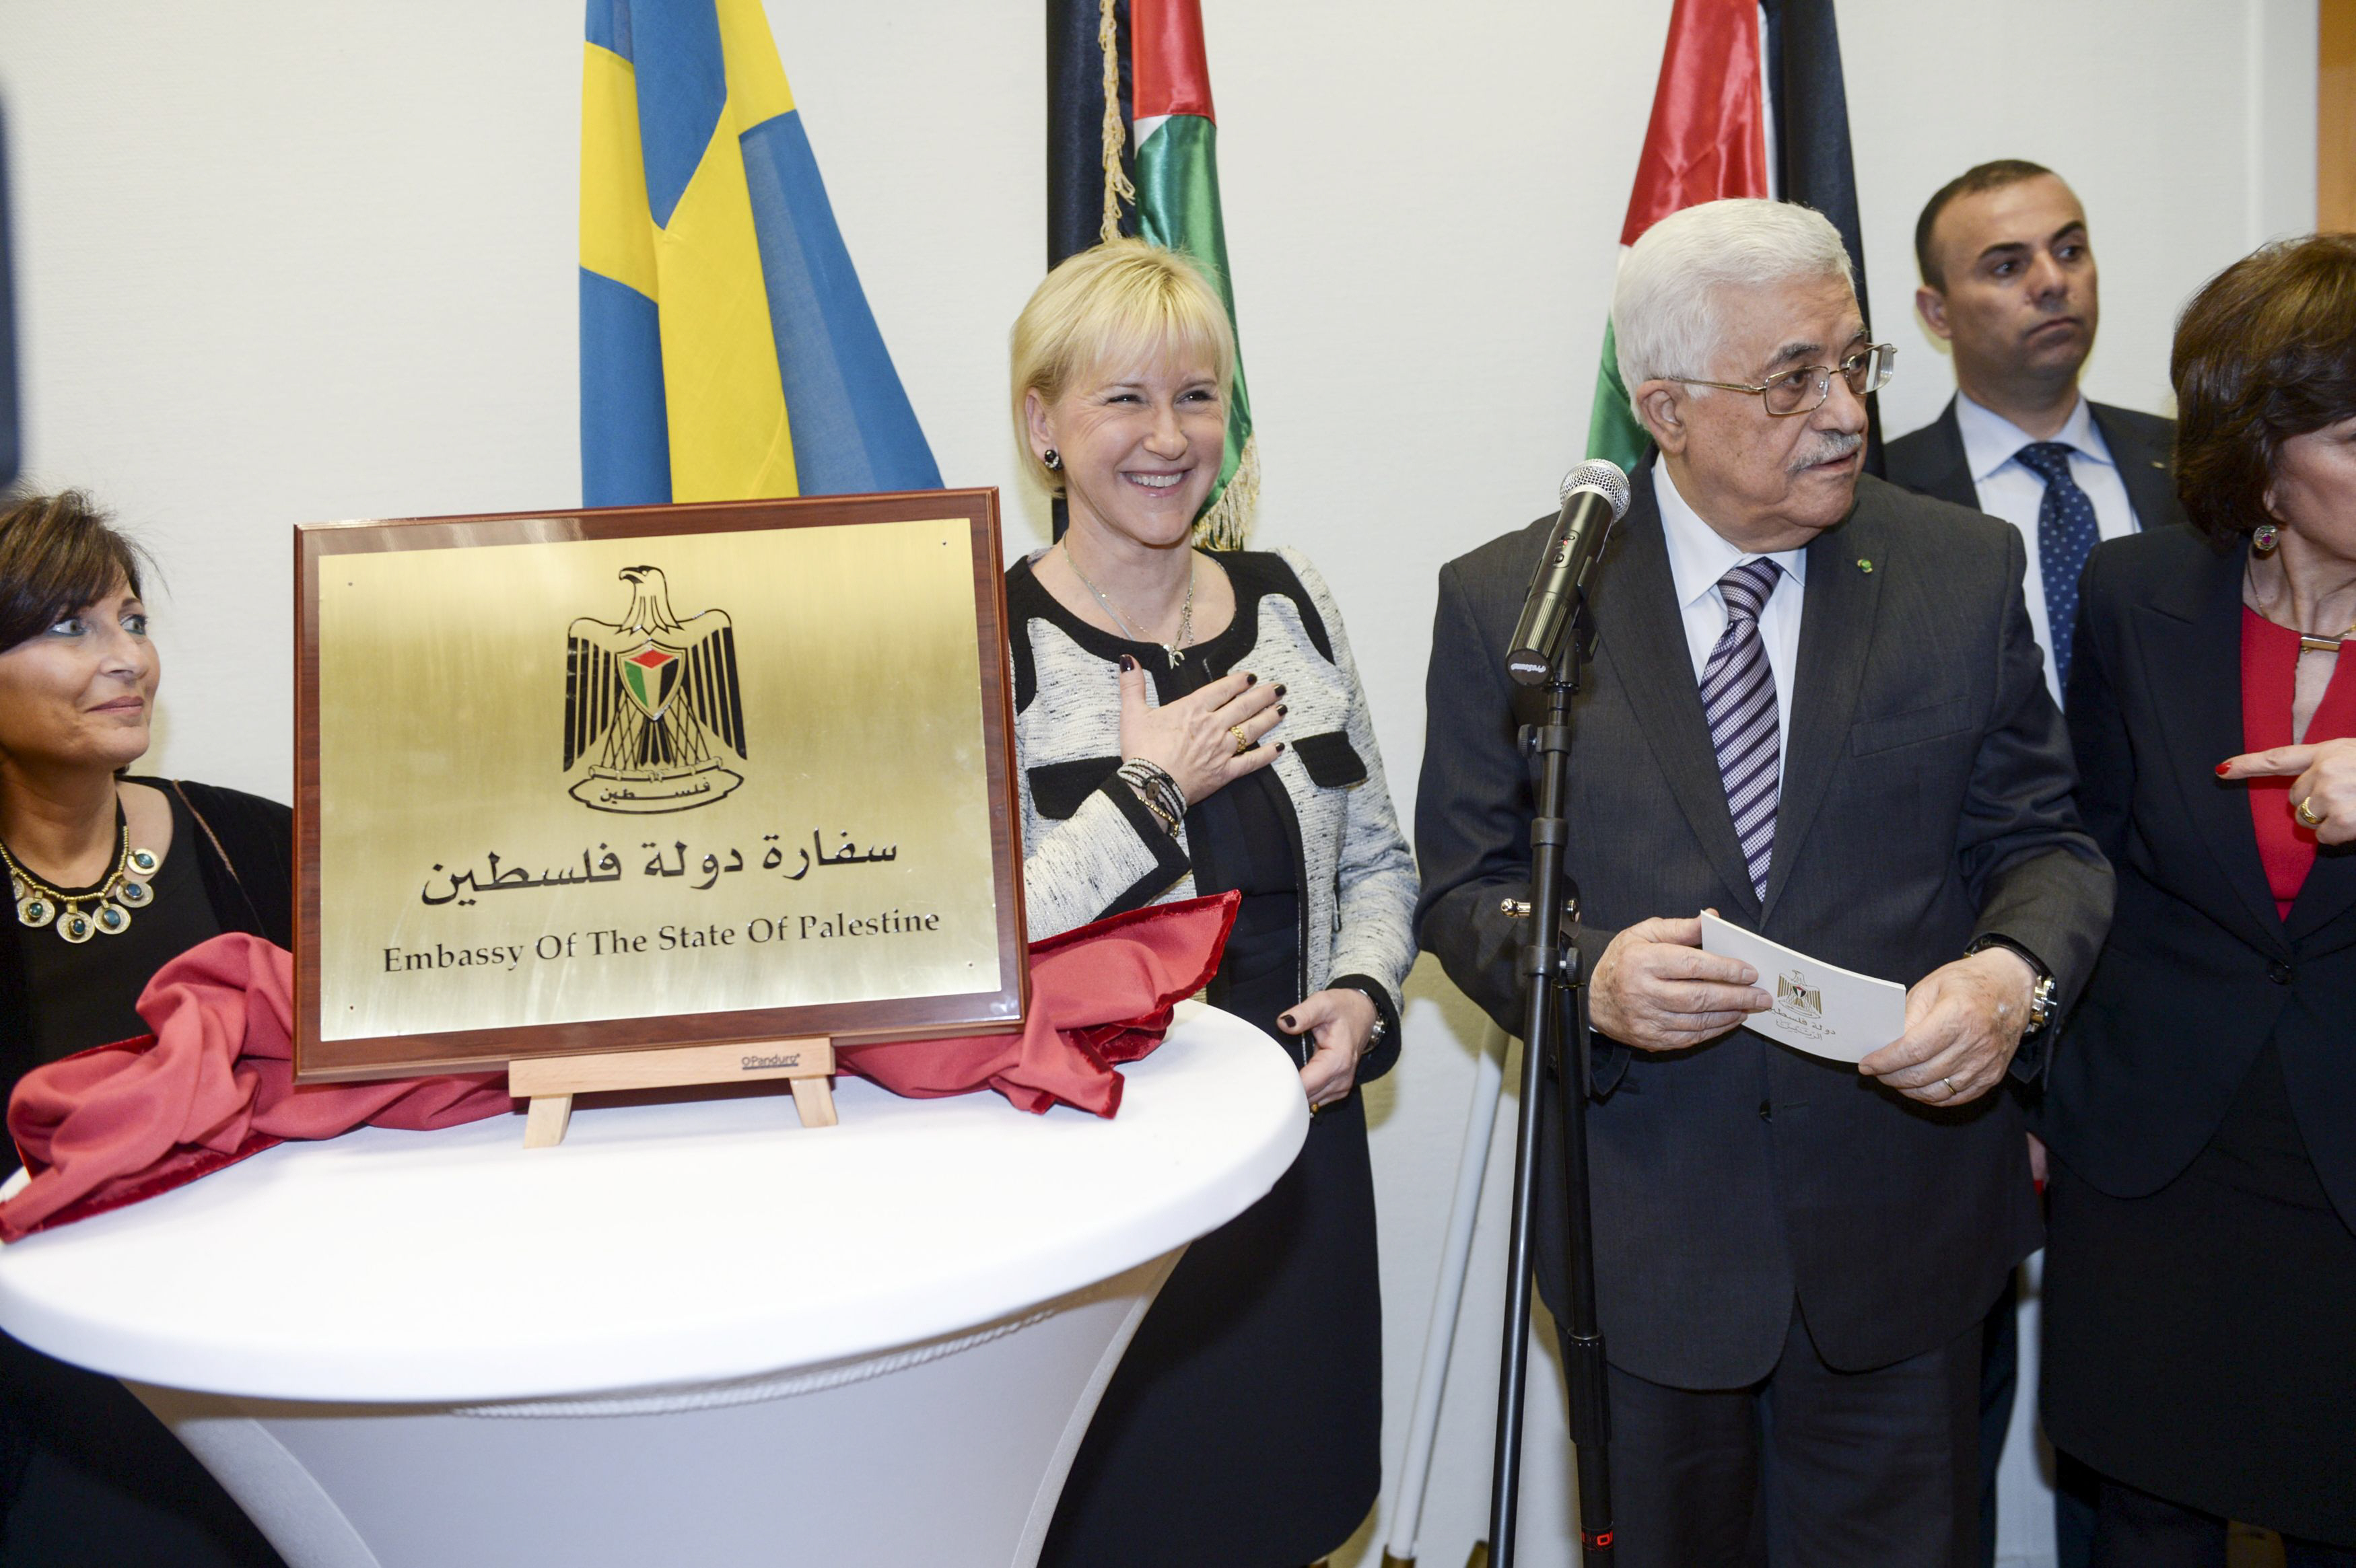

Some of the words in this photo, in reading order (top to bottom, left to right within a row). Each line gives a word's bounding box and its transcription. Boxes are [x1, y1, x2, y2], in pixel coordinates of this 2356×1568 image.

[599, 777, 712, 805] فلسطين
[421, 842, 622, 906] فلسطين
[641, 840, 744, 890] دولة
[762, 828, 898, 882] سفارة
[383, 942, 524, 972] Embassy
[536, 932, 577, 960] Of
[586, 929, 647, 956] The
[658, 924, 735, 951] State
[747, 915, 788, 943] Of
[799, 908, 940, 939] Palestine
